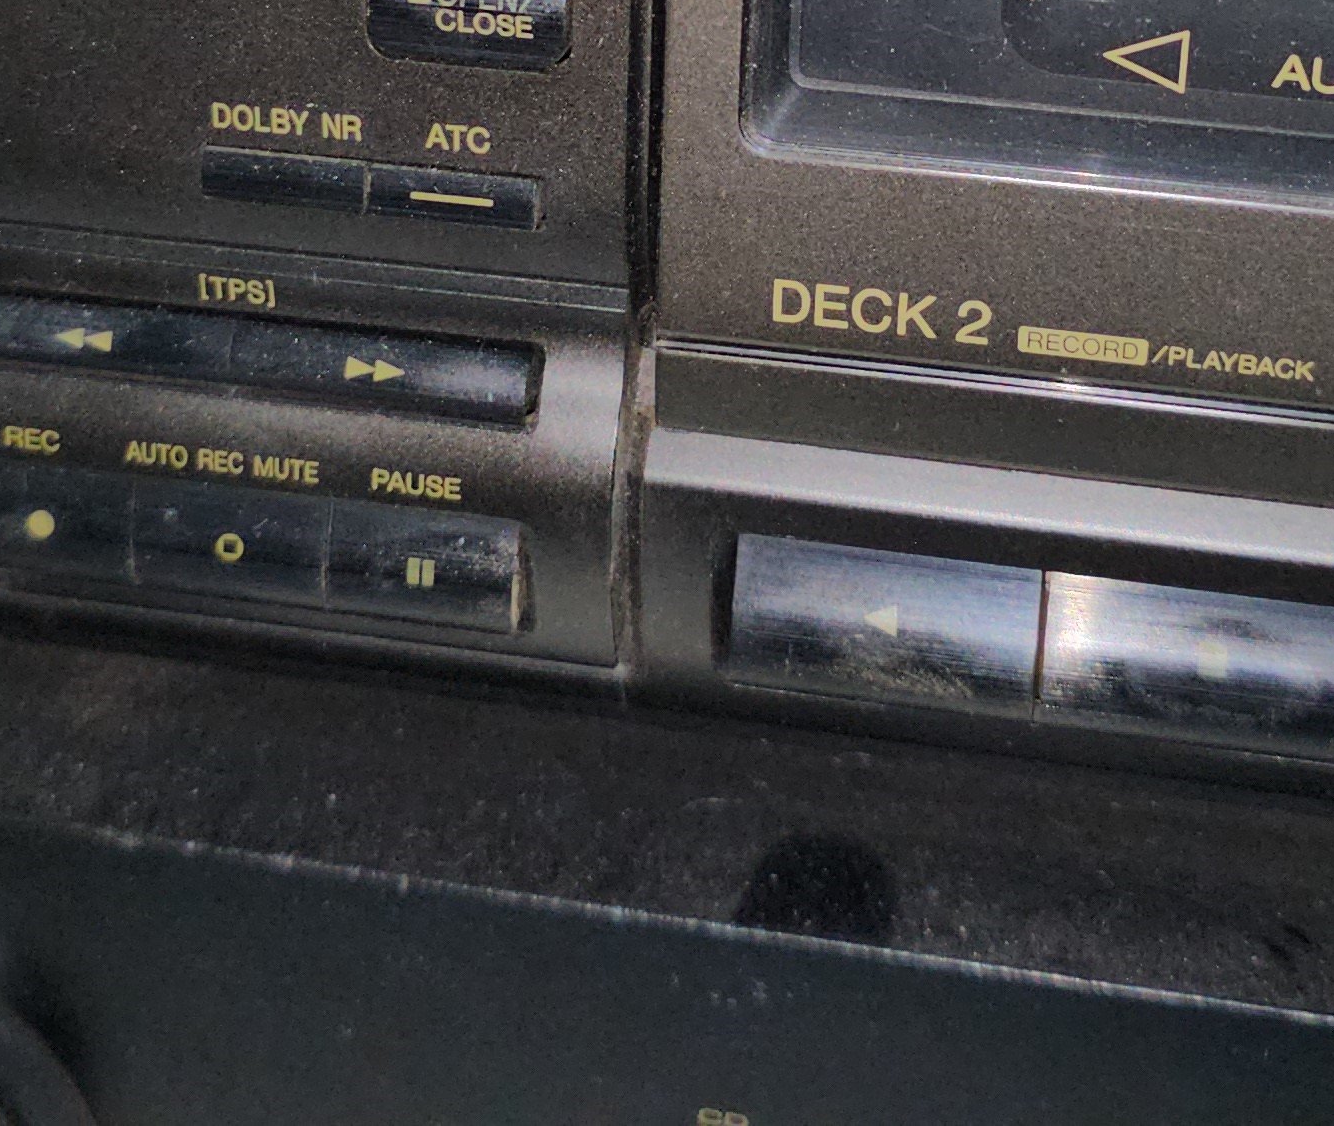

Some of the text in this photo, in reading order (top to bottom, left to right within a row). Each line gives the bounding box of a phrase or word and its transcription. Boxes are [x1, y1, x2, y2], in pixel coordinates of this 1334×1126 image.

[434, 10, 535, 39] CLOSE
[210, 102, 363, 141] DOLBY NR
[425, 124, 492, 155] ATC
[198, 273, 276, 308] [TPS]
[772, 278, 937, 340] DECK
[955, 300, 993, 346] 2
[1025, 330, 1140, 361] RECORD
[2, 425, 61, 454] REC
[125, 440, 319, 484] AUTO REC MUTE
[371, 468, 462, 500] PAUSE
